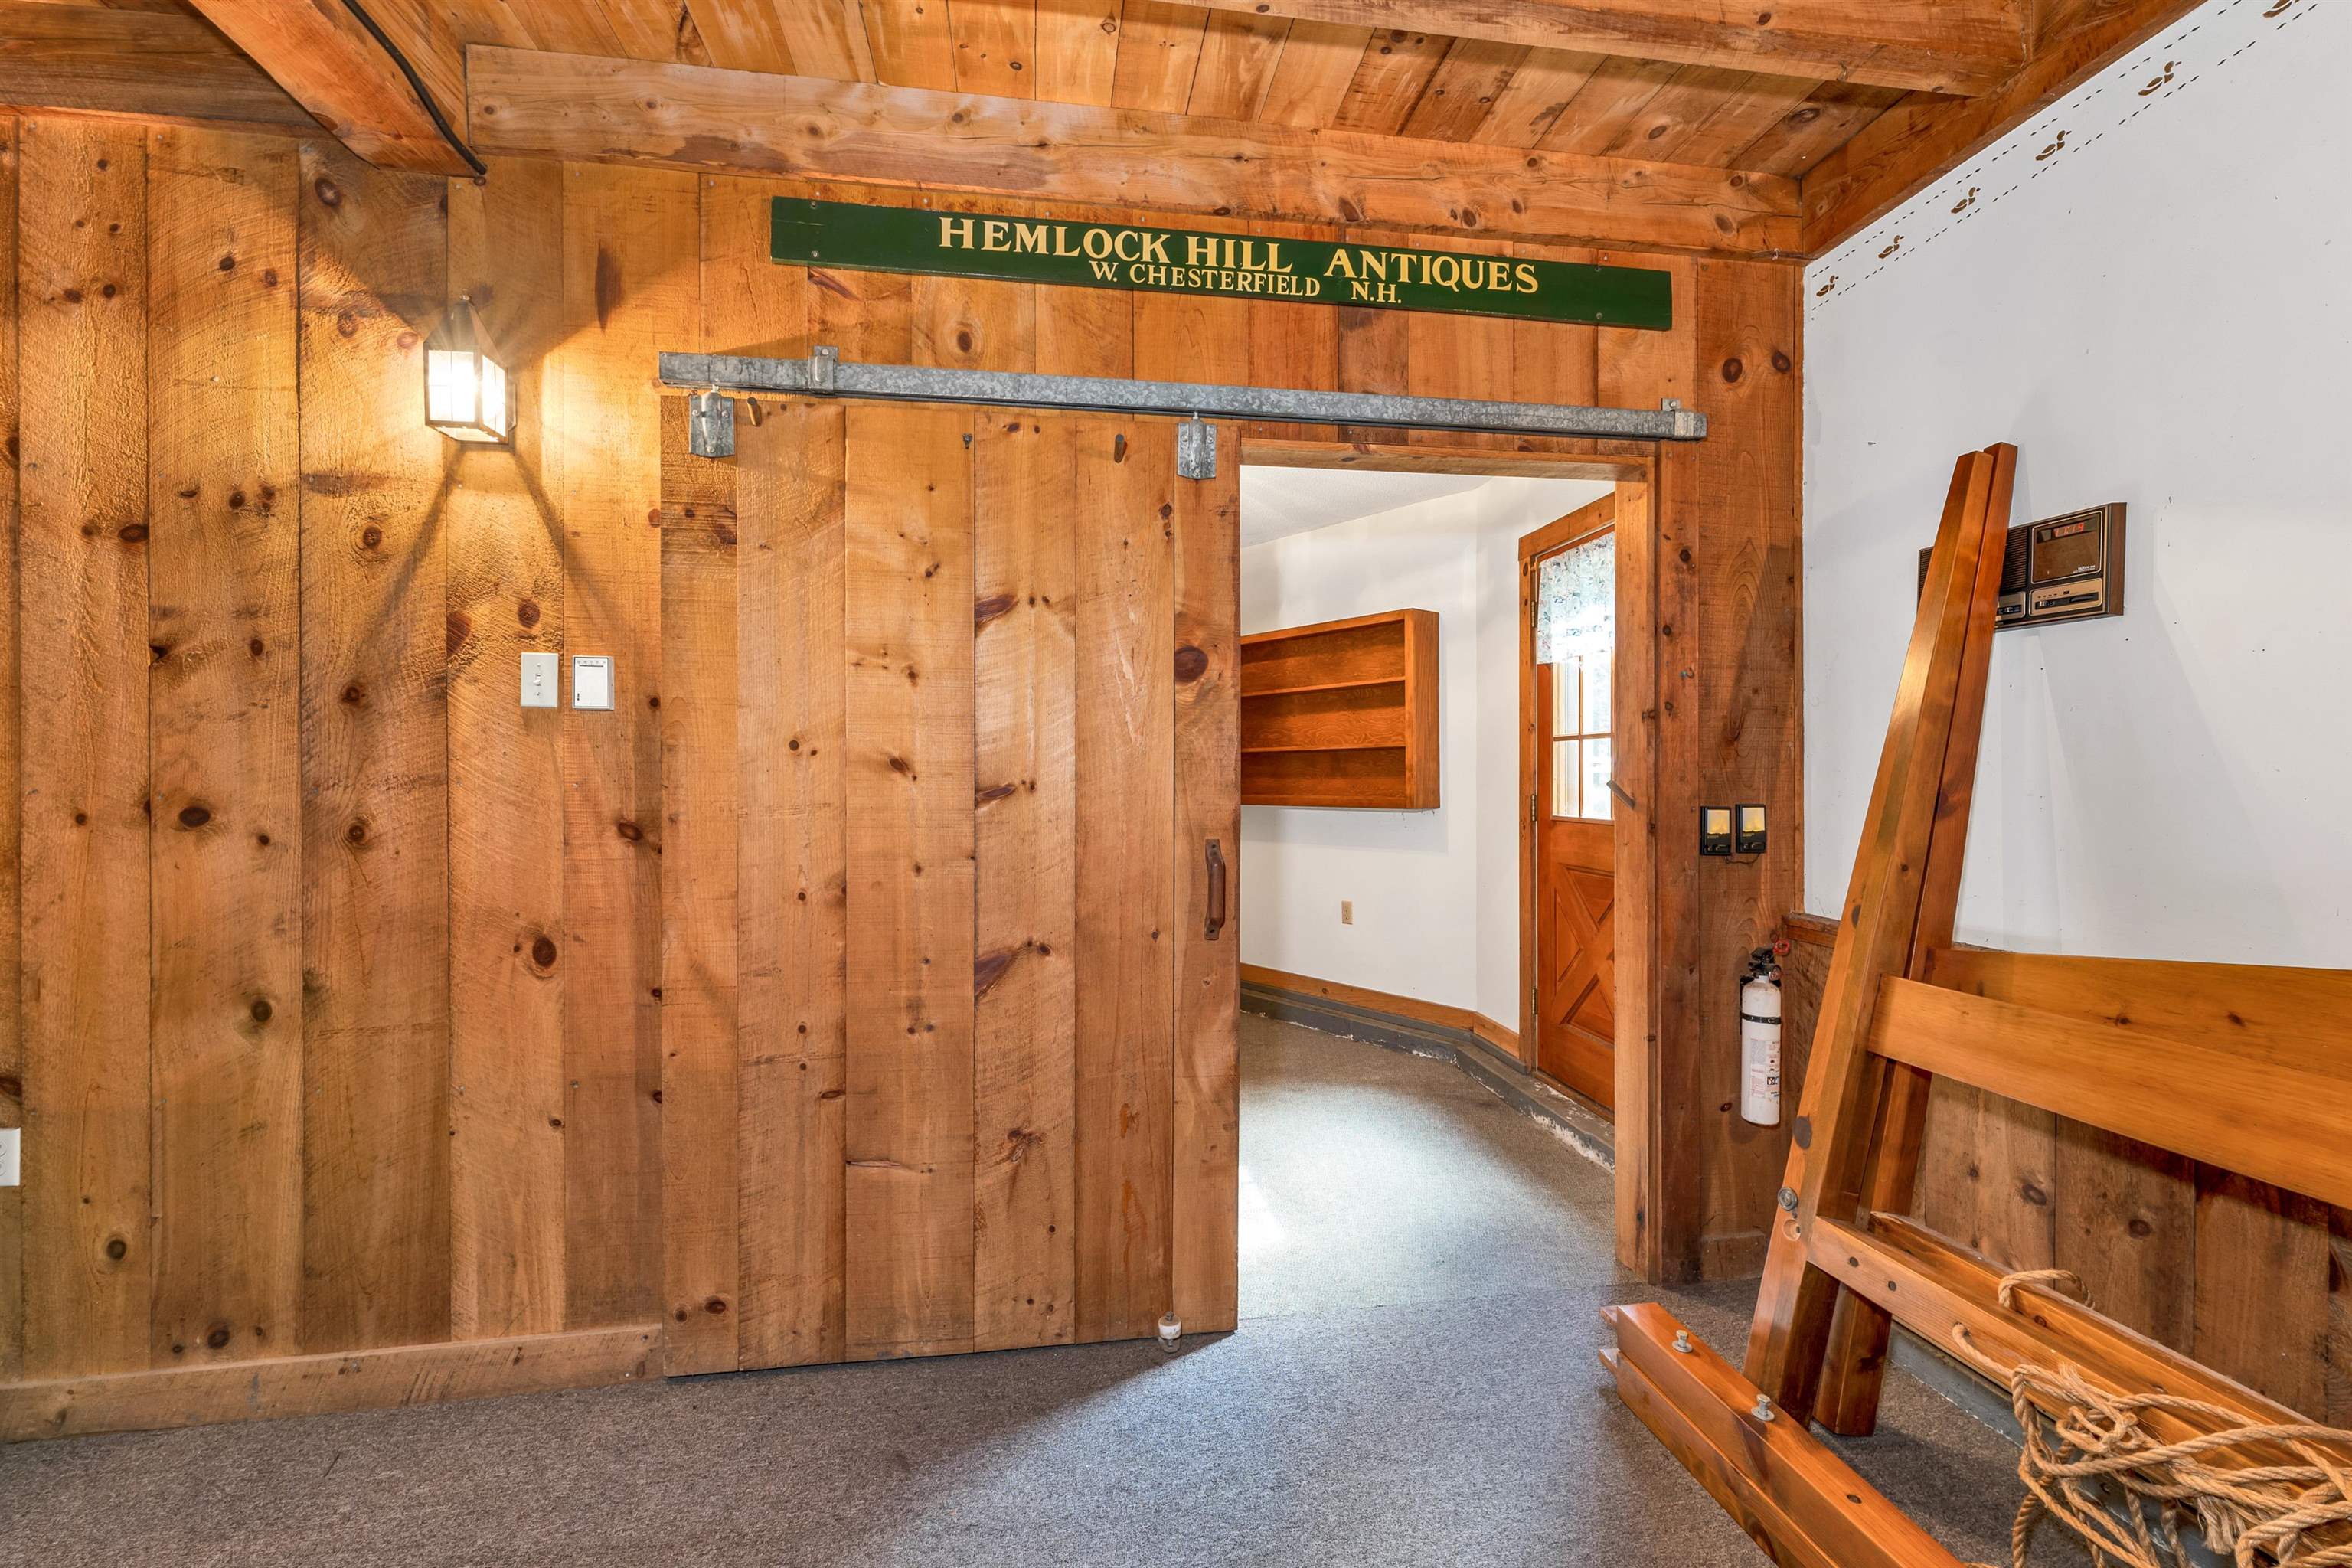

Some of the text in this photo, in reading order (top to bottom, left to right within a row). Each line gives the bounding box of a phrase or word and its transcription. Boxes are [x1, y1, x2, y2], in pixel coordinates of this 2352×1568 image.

[939, 217, 1538, 292] HEMLOCK HILL ANTIQUES
[1089, 260, 1402, 303] W. CHESTERFIELD N.H.
